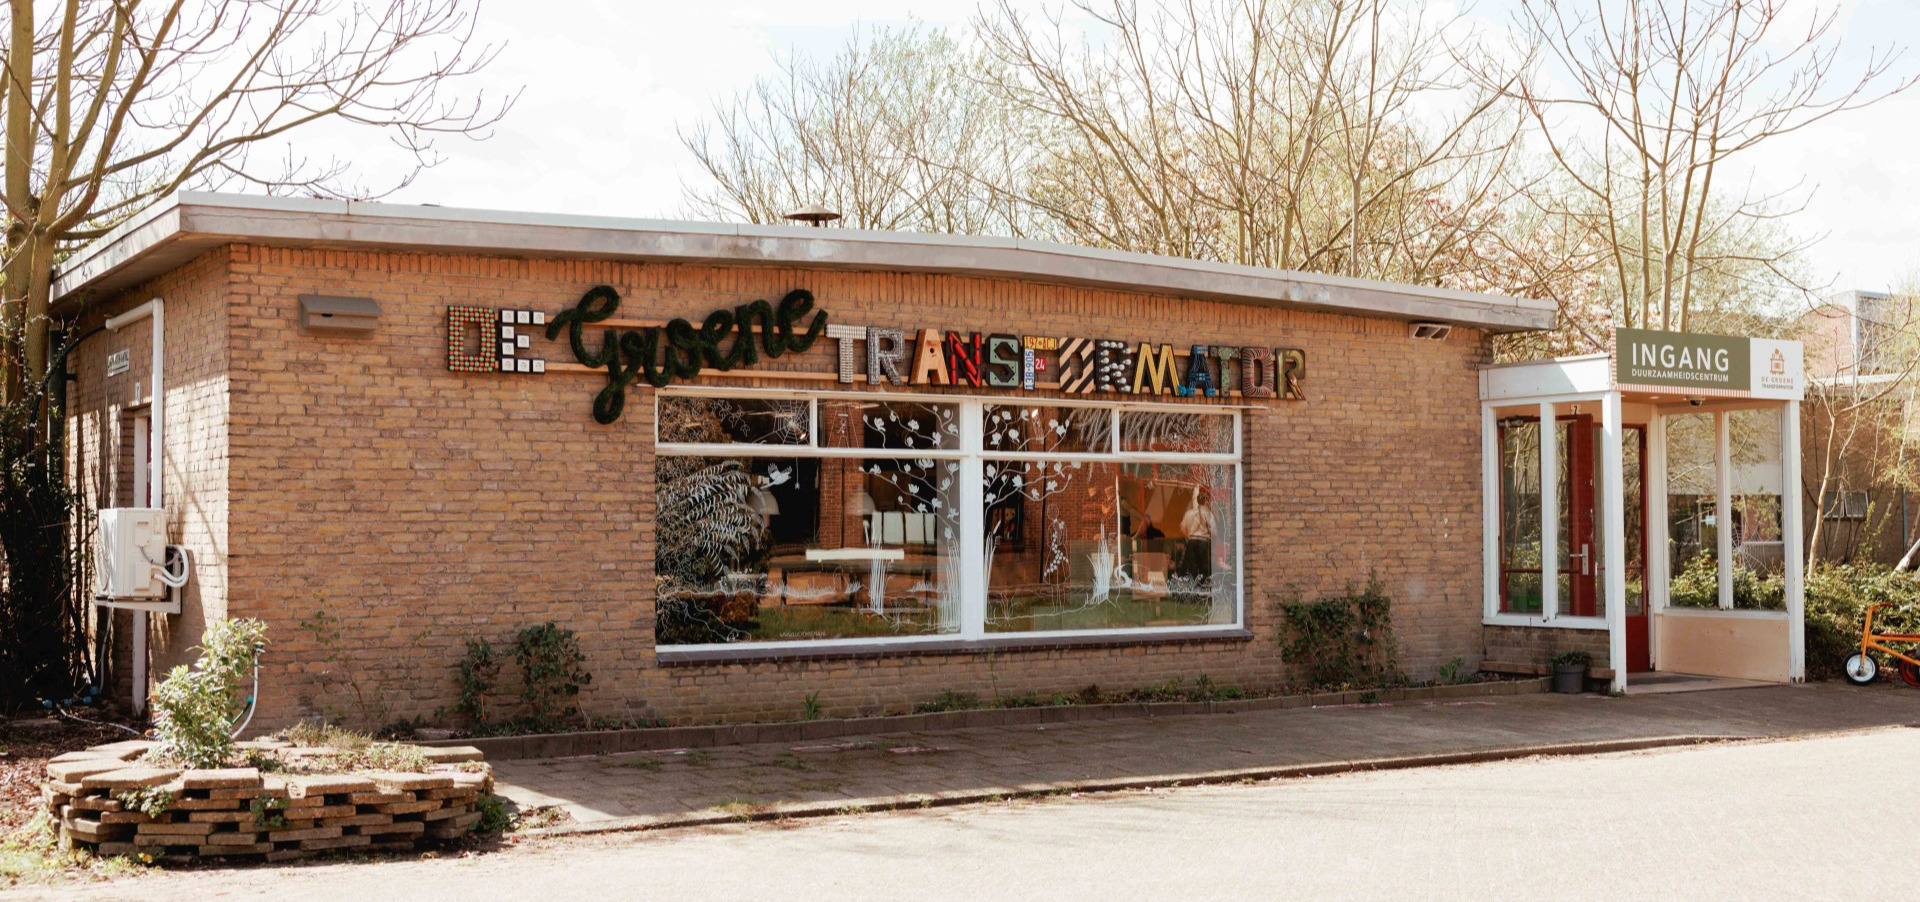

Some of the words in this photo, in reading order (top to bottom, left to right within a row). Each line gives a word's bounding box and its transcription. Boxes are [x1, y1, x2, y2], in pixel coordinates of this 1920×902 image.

[448, 304, 545, 374] DE
[545, 284, 829, 425] Groene
[825, 322, 1306, 400] TRANSFORMATOR
[1035, 358, 1045, 370] 24
[1632, 342, 1729, 372] INGANG
[1631, 368, 1729, 383] DUURZAAMHEIDSCENTRUM
